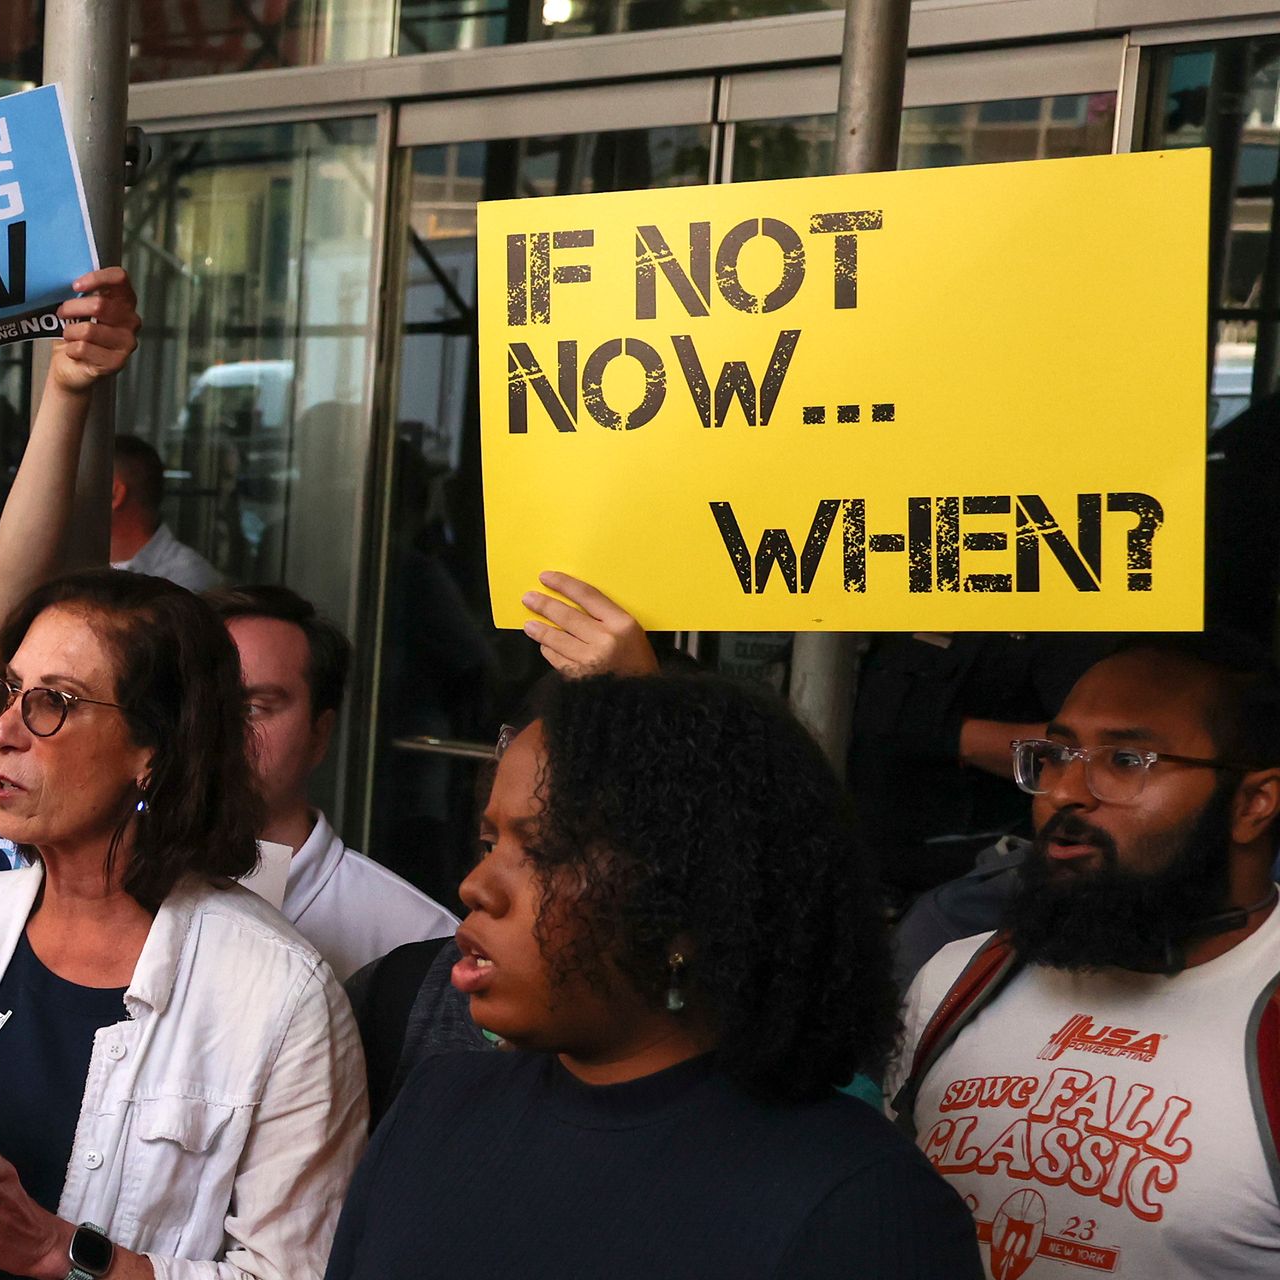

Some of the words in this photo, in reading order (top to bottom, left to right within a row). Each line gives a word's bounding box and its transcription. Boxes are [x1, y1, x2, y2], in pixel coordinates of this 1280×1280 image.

[507, 229, 595, 326] IF
[635, 209, 884, 321] NOT
[508, 329, 897, 434] NOW...
[708, 492, 1165, 595] WHEN?
[1067, 1041, 1156, 1063] POWERLIFTING
[1077, 1023, 1161, 1056] USA
[939, 1075, 1039, 1113] SBWC
[1028, 1067, 1193, 1164] FALL
[928, 1115, 1178, 1222] CLASSIC
[1047, 1243, 1074, 1256] NEW
[1076, 1249, 1106, 1264] YORK
[1060, 1216, 1098, 1242] 23
